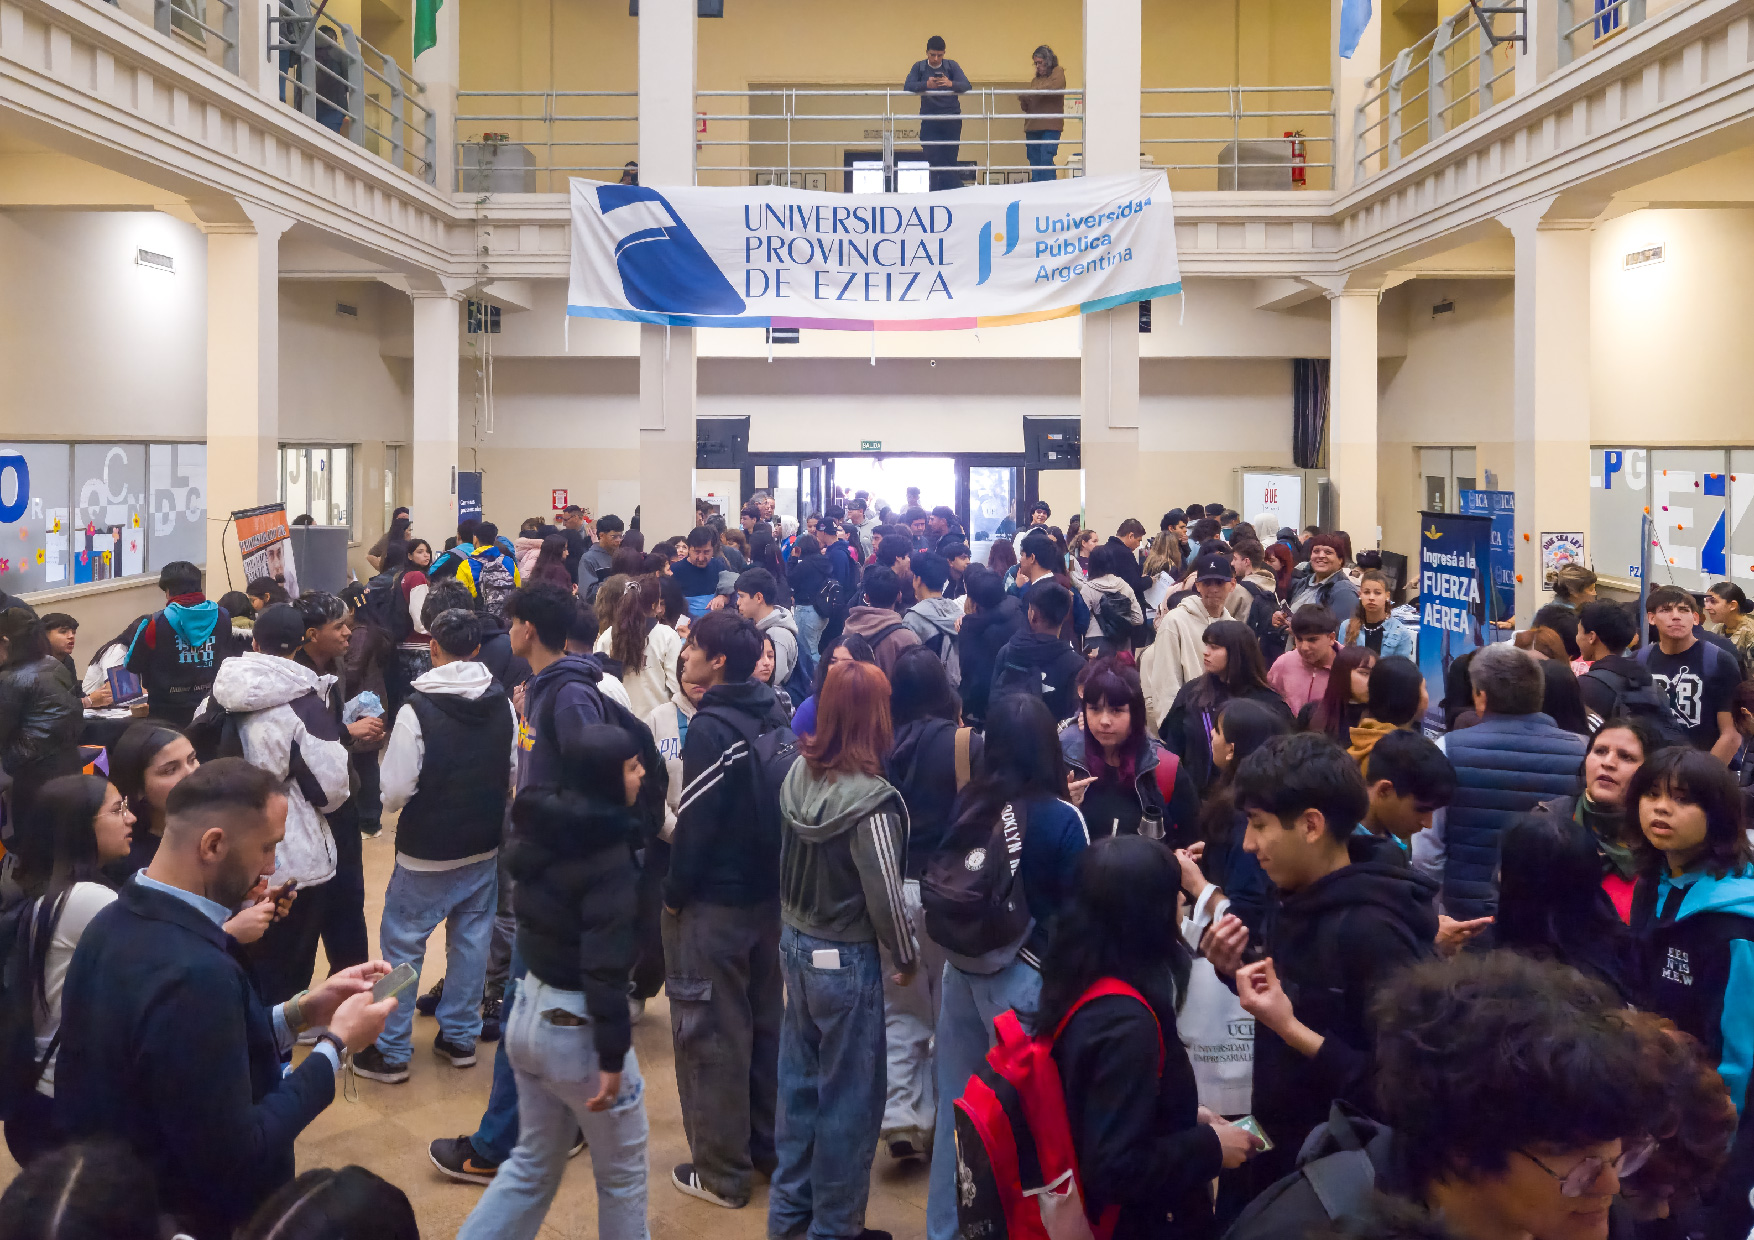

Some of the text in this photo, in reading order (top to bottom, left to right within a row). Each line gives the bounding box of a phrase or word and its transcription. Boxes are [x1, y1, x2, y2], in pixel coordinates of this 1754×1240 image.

[744, 203, 953, 235] UNIVERSIDAD
[745, 235, 954, 267] PROVINCIAL
[1035, 233, 1112, 259] Pública
[1034, 247, 1133, 283] Argentina
[745, 268, 954, 302] DE EZEIZA
[1264, 488, 1278, 504] BUE
[1475, 493, 1489, 508] ICA
[1423, 546, 1476, 570] Ingresá a la
[1423, 570, 1481, 604] FUERZA
[1423, 599, 1470, 635] AÉREA
